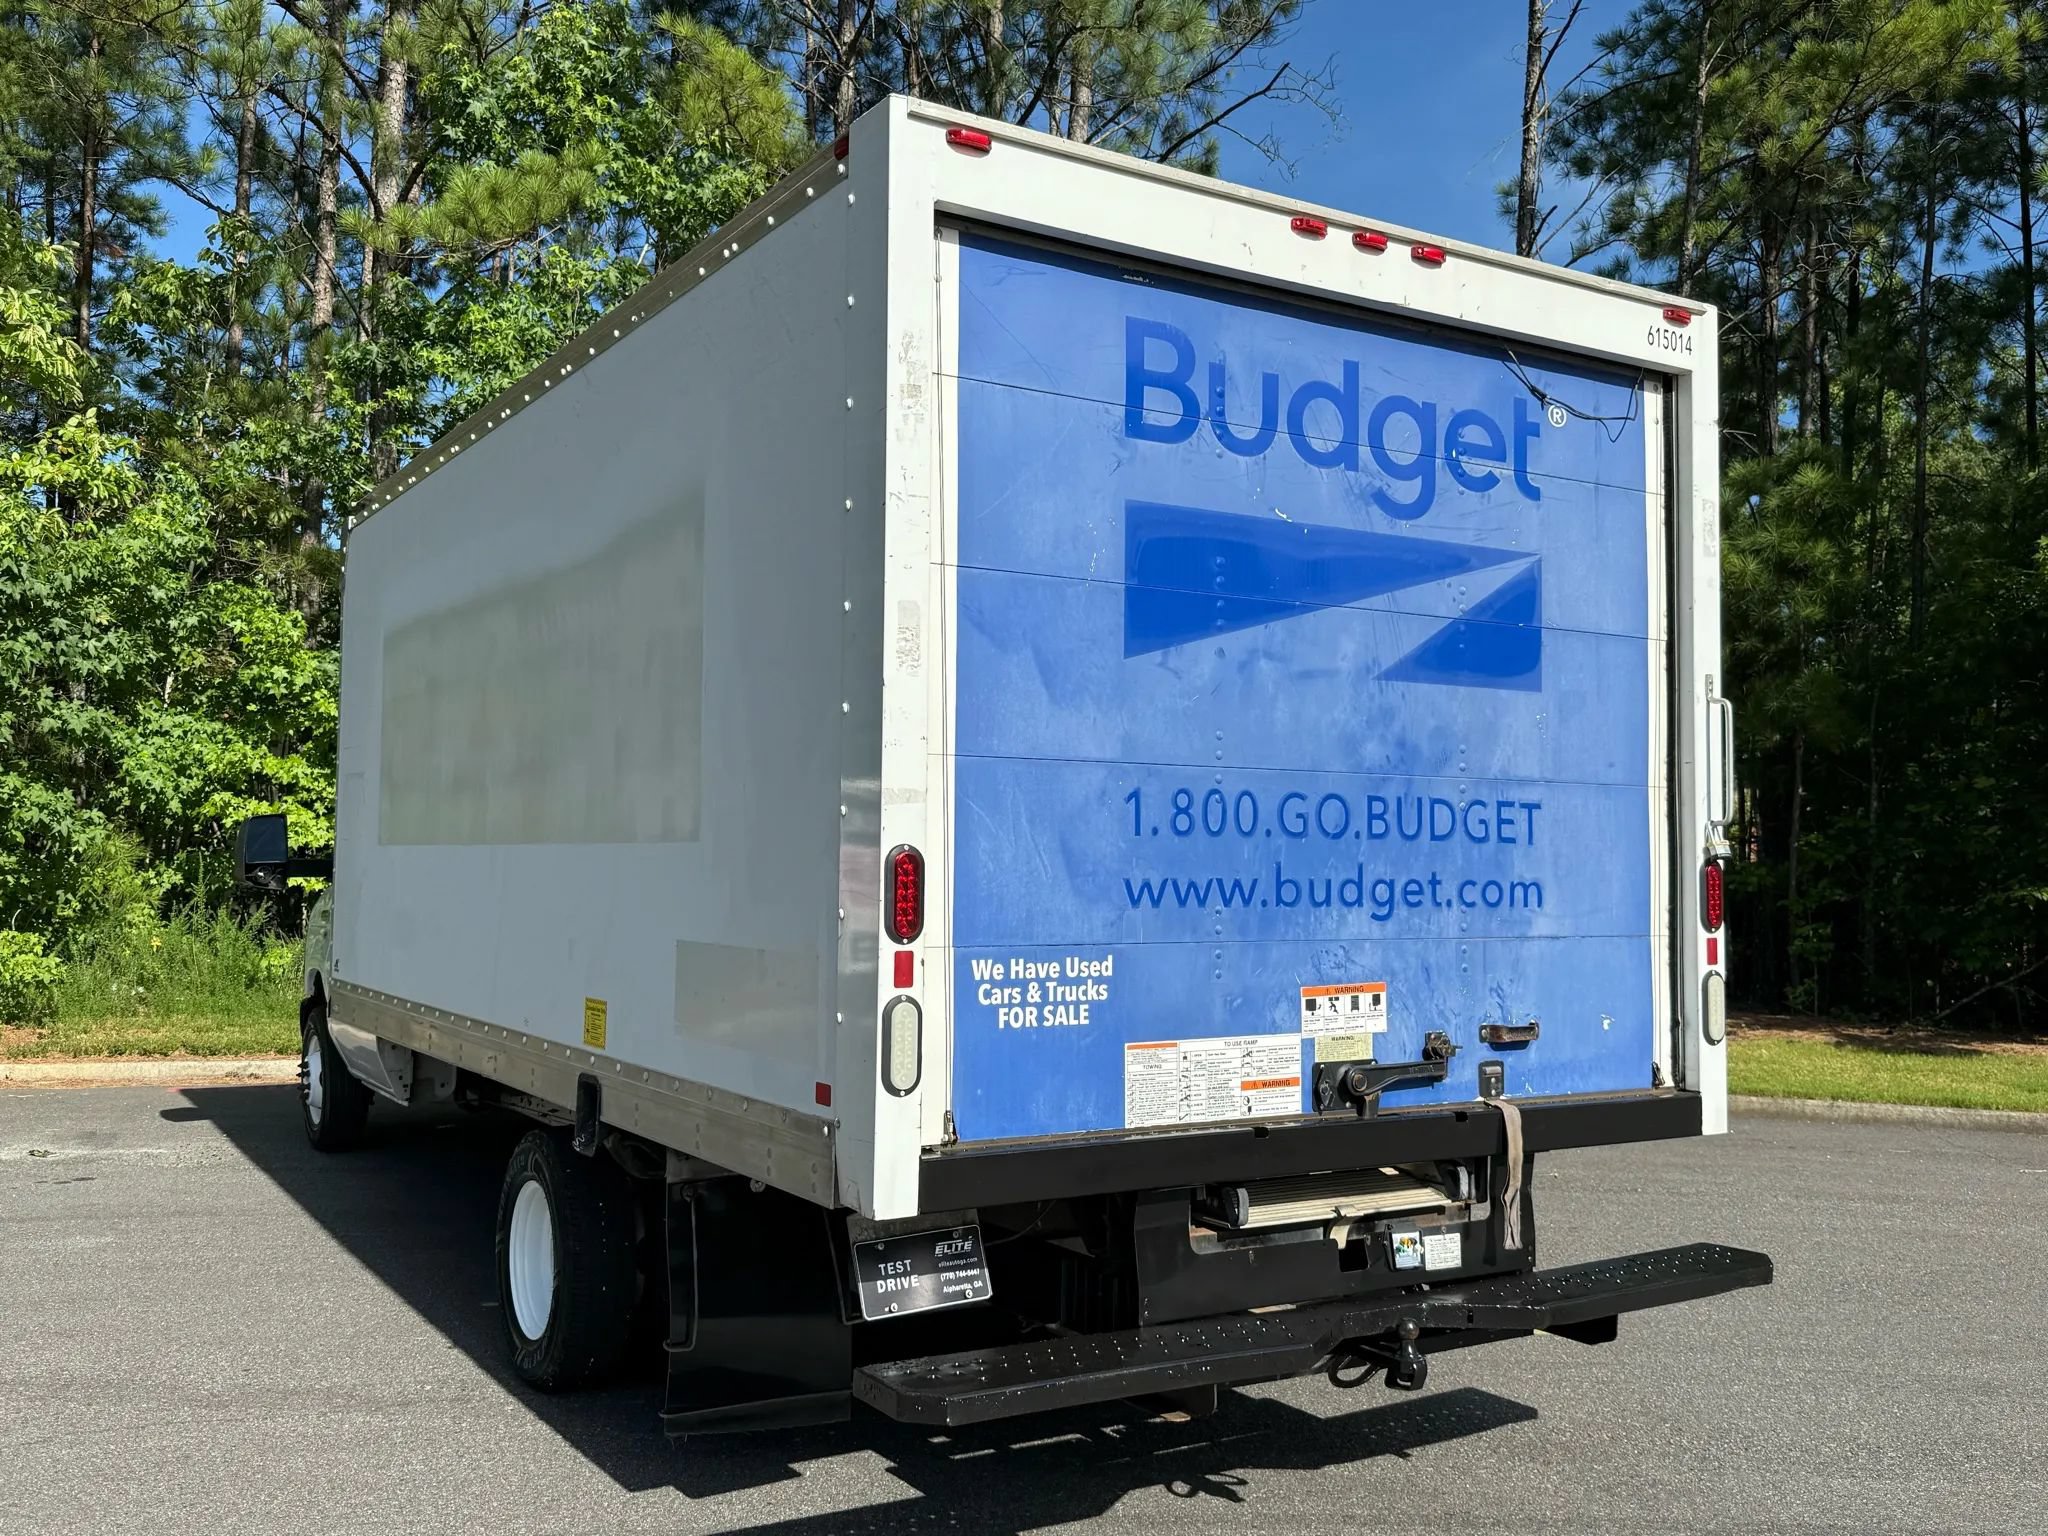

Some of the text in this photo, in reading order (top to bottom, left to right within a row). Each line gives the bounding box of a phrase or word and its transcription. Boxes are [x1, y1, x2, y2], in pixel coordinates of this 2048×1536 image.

[1647, 325, 1693, 356] 615014
[1125, 316, 1541, 520] Budget
[1123, 787, 1542, 846] 1.800.GO.BUDGET
[1123, 861, 1543, 921] www.budget.com
[971, 955, 1113, 981] We Have Used
[978, 979, 1108, 1006] Cars & Trucks
[1335, 985, 1365, 995] WARNING
[998, 1004, 1090, 1029] FOR SALE
[1261, 1079, 1291, 1088] WARNING
[935, 1240, 973, 1255] ELITE
[878, 1259, 912, 1275] TEST
[877, 1275, 920, 1293] DRIVE
